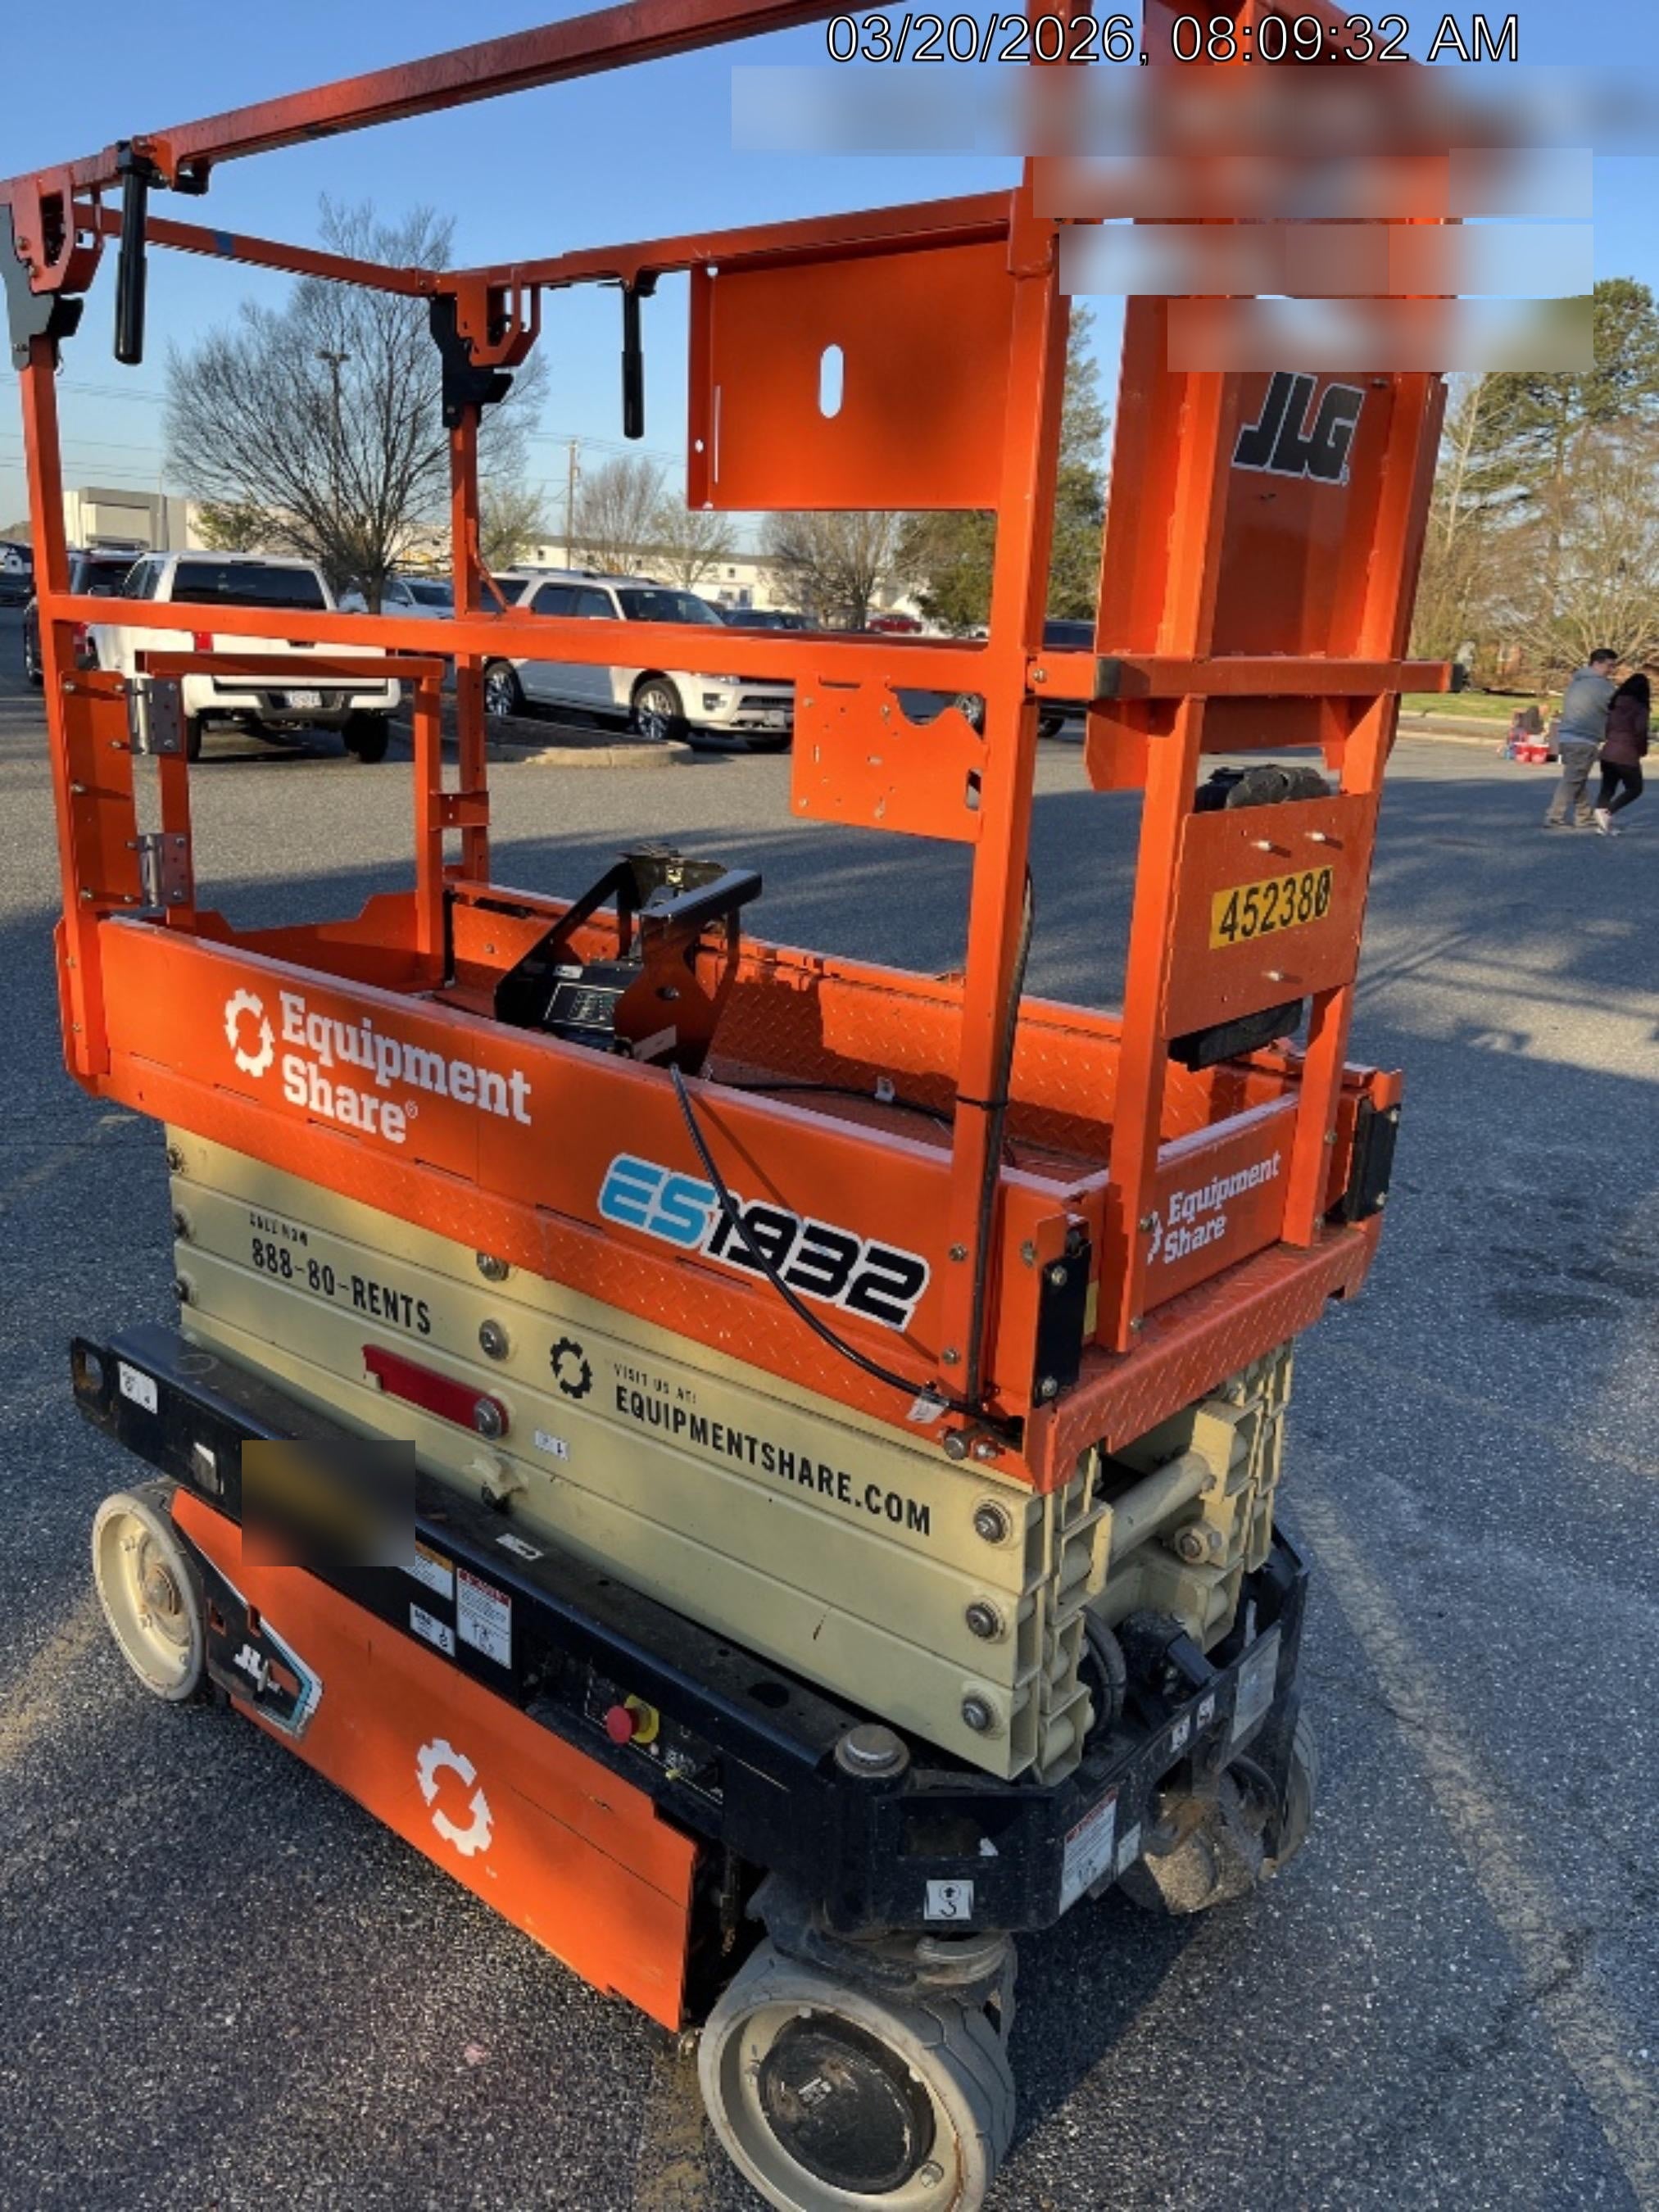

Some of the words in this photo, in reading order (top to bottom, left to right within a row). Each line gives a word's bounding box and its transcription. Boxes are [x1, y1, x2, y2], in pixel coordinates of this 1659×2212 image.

[1231, 372, 1367, 487] JLG
[1219, 869, 1331, 942] 452380
[279, 990, 532, 1126] Equipment
[1167, 1149, 1281, 1226] Equipment
[252, 1238, 431, 1335] 888-80-RENTS
[598, 1154, 929, 1330] ES1932
[1163, 1214, 1227, 1264] Share
[614, 1362, 647, 1387] VISIT
[615, 1385, 931, 1536] EQUIPMENTSHARE.COM
